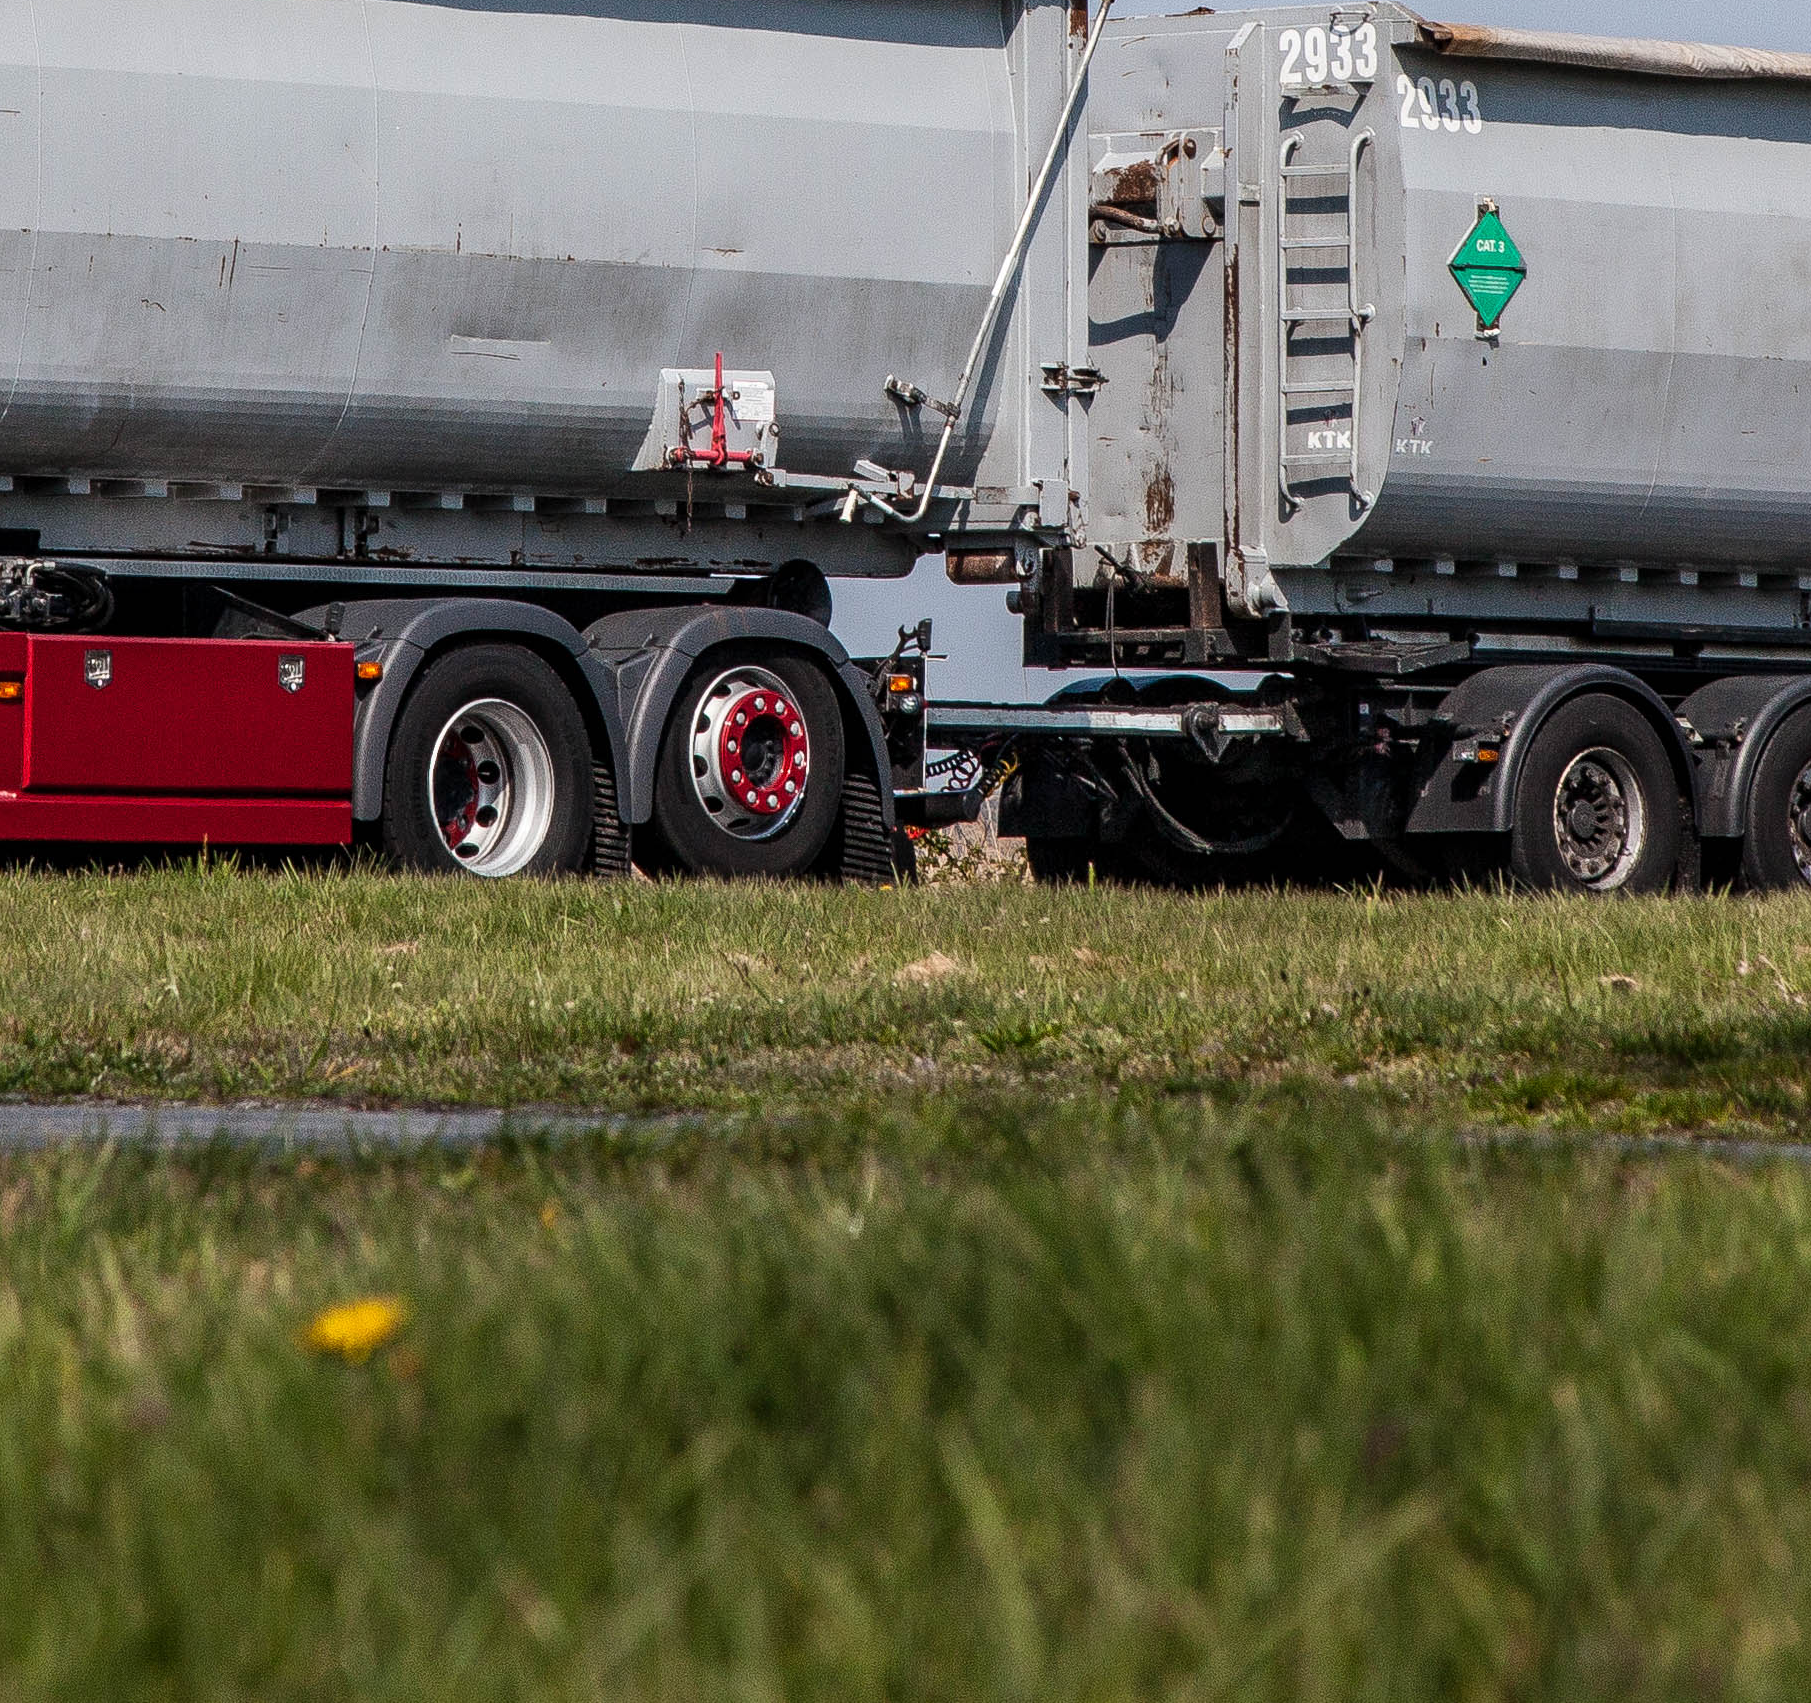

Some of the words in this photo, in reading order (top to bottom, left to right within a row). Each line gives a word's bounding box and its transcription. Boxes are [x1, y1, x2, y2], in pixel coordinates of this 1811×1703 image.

[1279, 22, 1378, 83] 2933
[1396, 73, 1483, 135] 2933
[1498, 240, 1506, 253] 3
[1307, 430, 1351, 449] KTK
[1395, 438, 1433, 454] KTK
